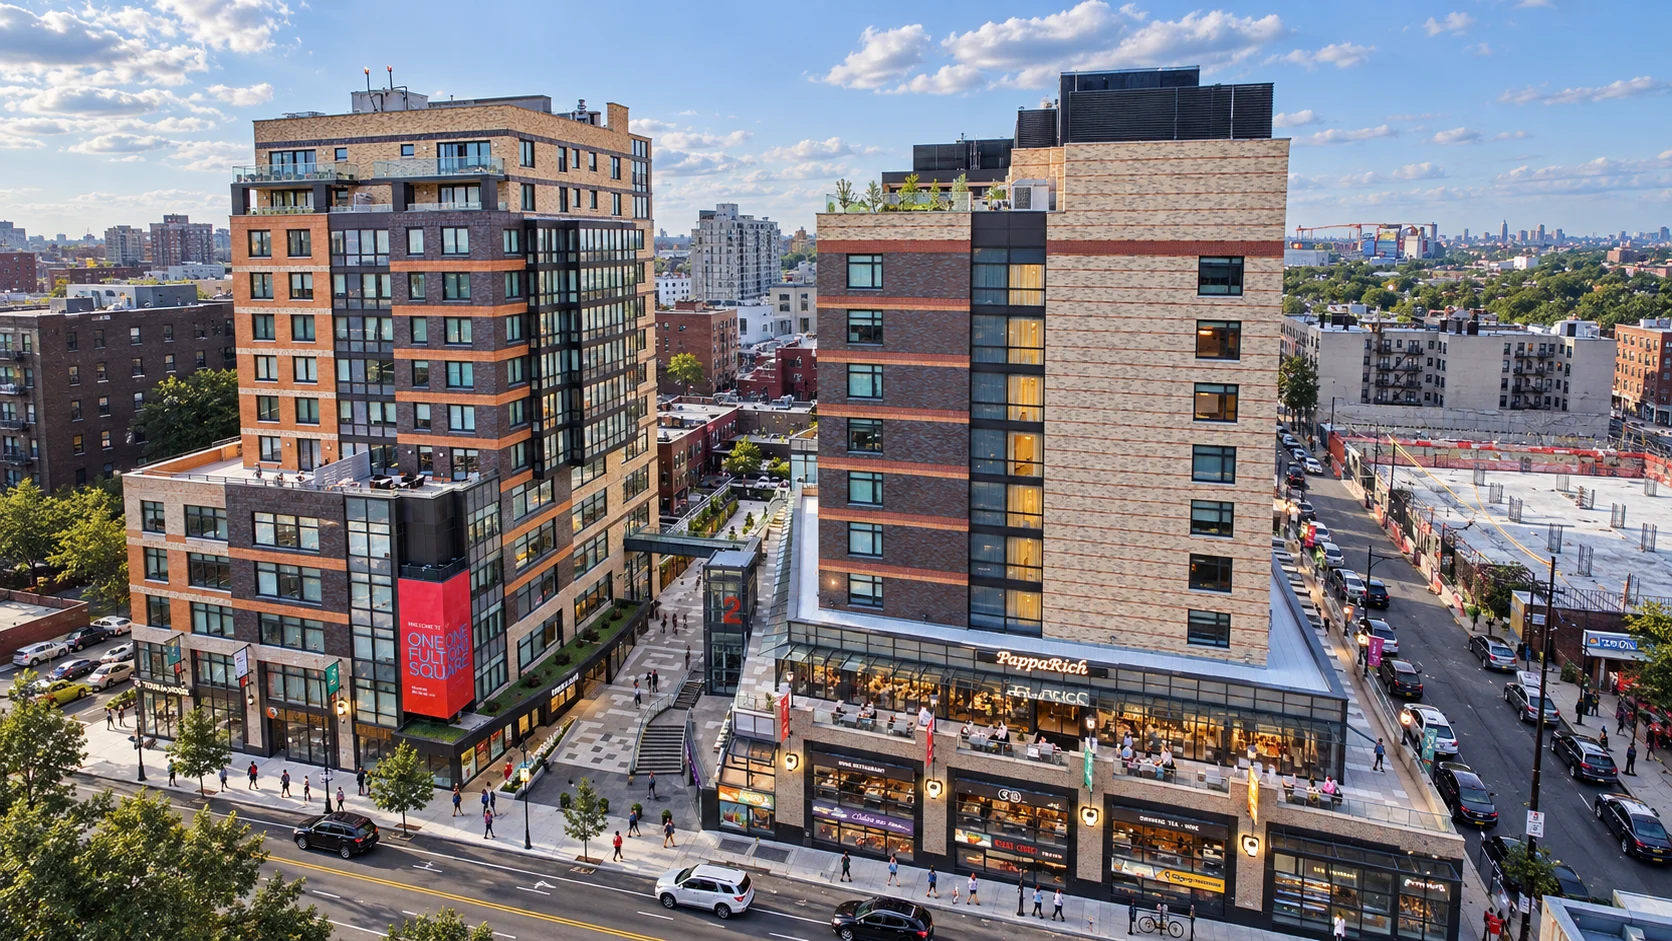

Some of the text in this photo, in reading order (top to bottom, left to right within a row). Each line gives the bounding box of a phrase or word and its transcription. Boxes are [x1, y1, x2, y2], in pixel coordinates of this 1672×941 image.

[723, 595, 743, 625] 2
[407, 632, 445, 651] ONE
[996, 651, 1089, 675] PappaRich
